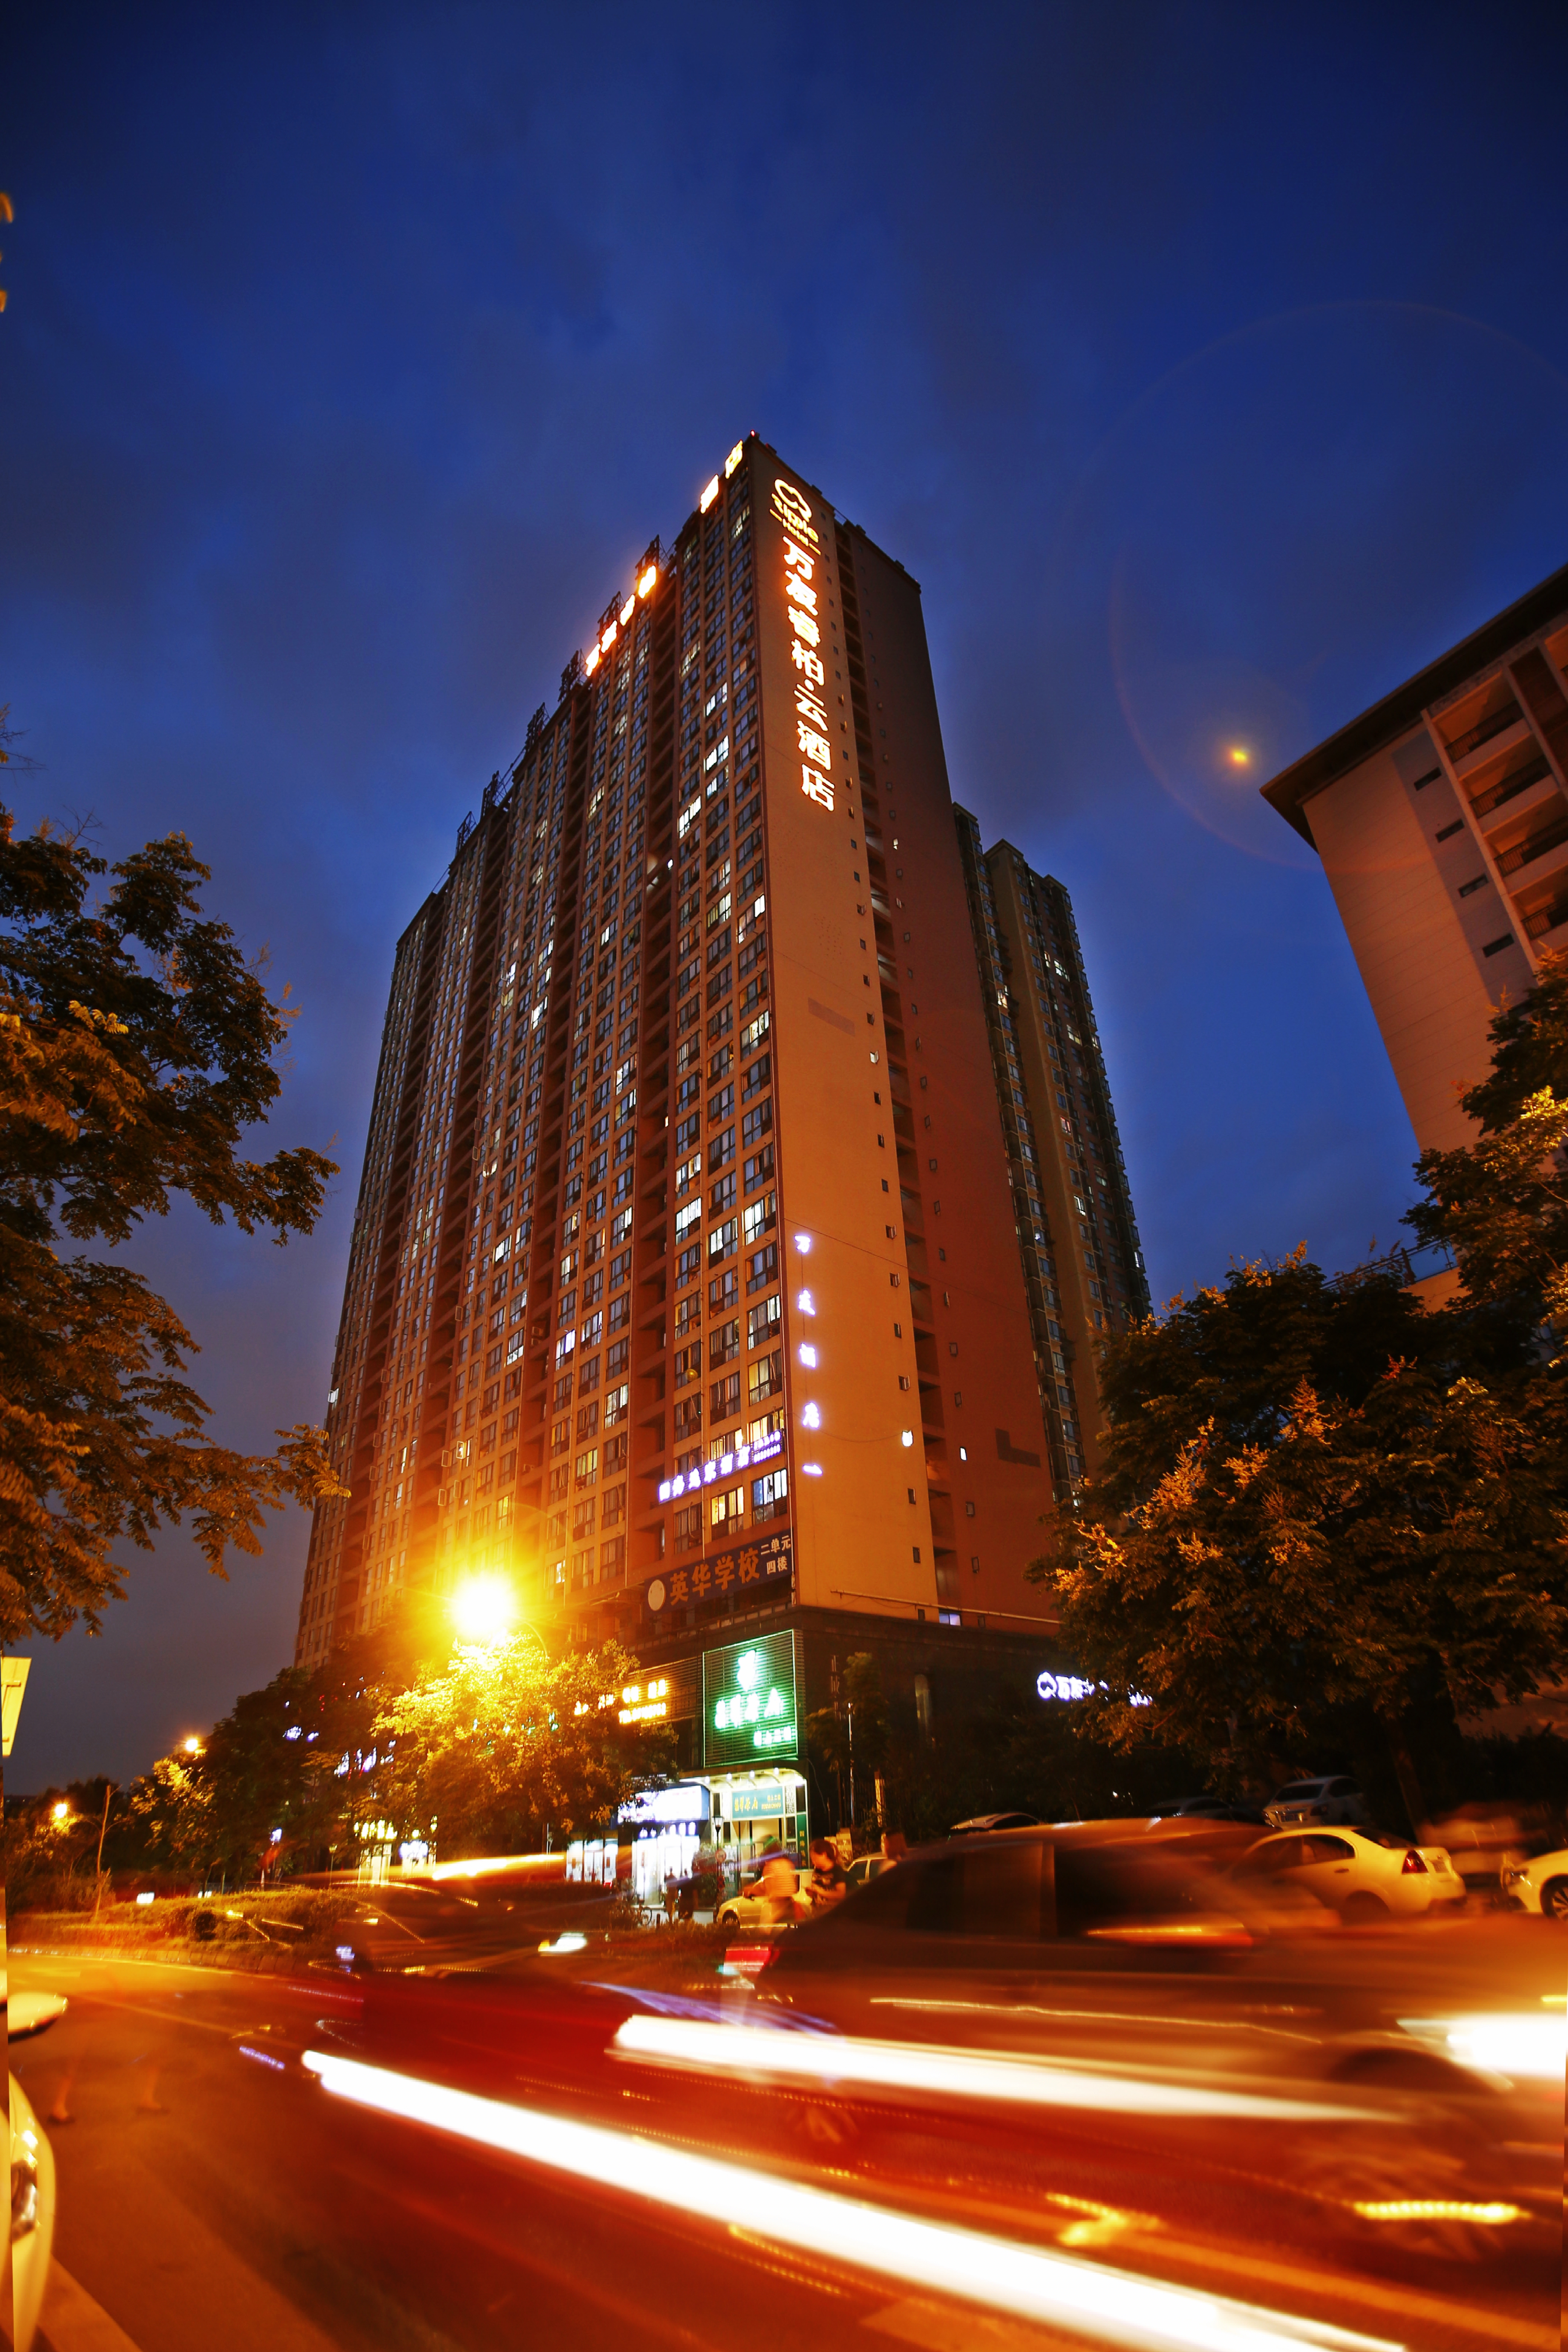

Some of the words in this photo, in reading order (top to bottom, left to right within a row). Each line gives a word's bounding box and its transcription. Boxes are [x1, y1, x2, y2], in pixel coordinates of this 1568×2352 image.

[761, 1535, 791, 1555] 二单元
[767, 1556, 788, 1575] 四楼
[670, 1547, 760, 1606] 英华学校
